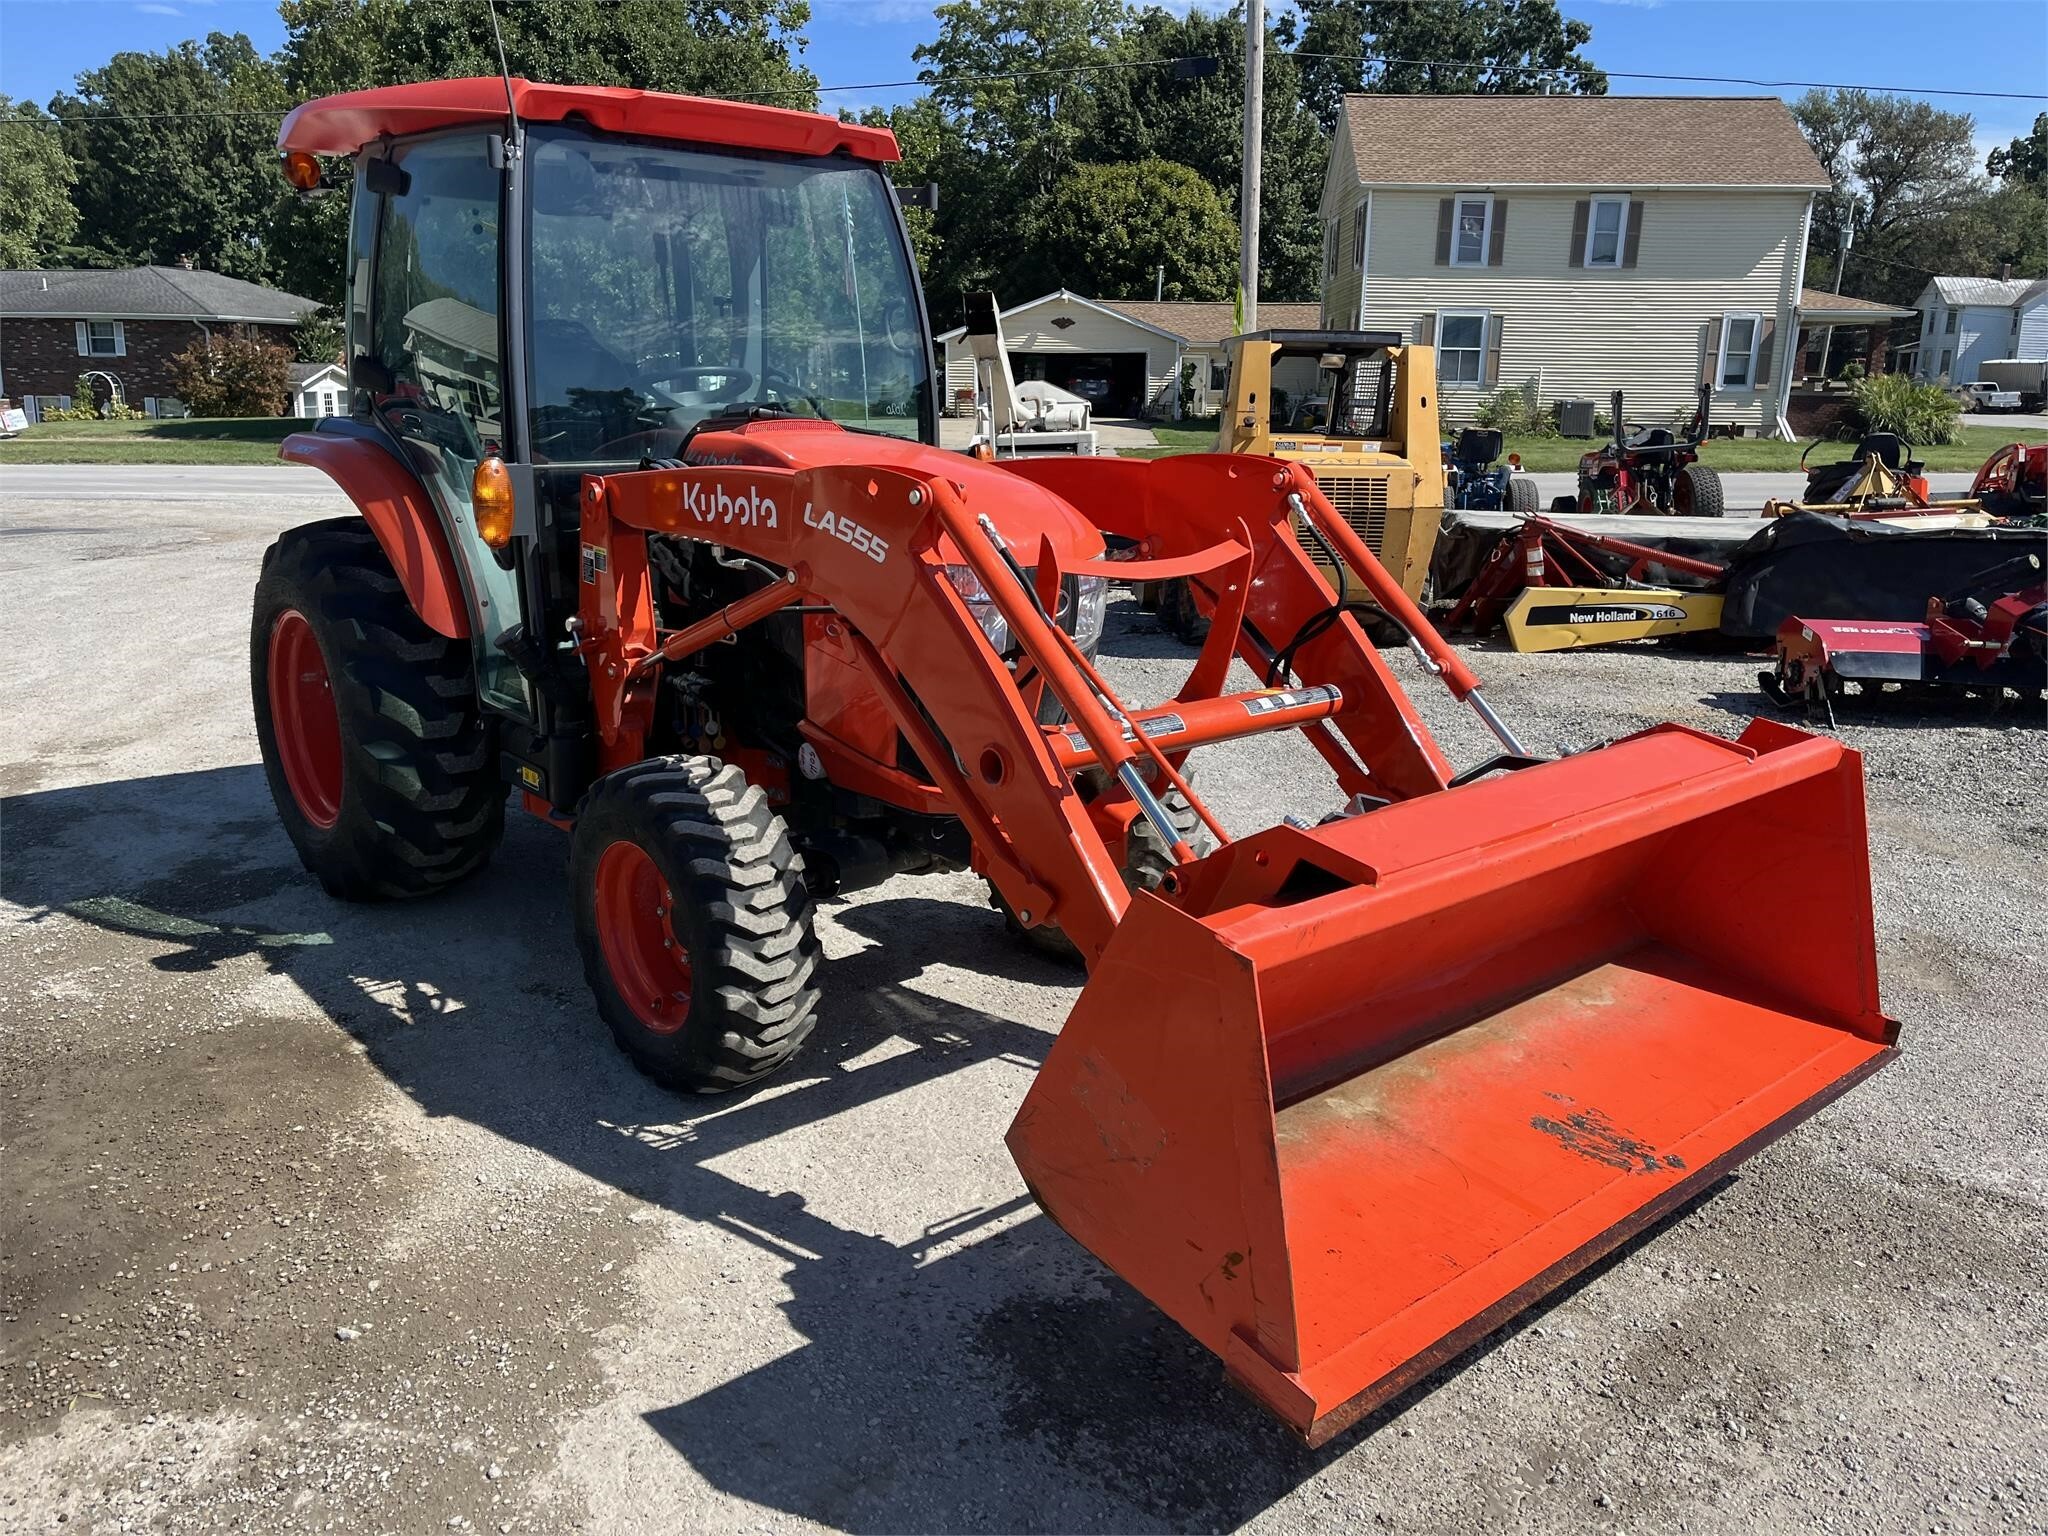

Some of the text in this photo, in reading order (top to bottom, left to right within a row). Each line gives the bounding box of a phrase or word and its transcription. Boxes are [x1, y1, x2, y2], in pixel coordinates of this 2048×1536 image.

[683, 481, 778, 529] Kubota
[803, 502, 890, 564] LA555
[1569, 609, 1676, 623] New Holland 616
